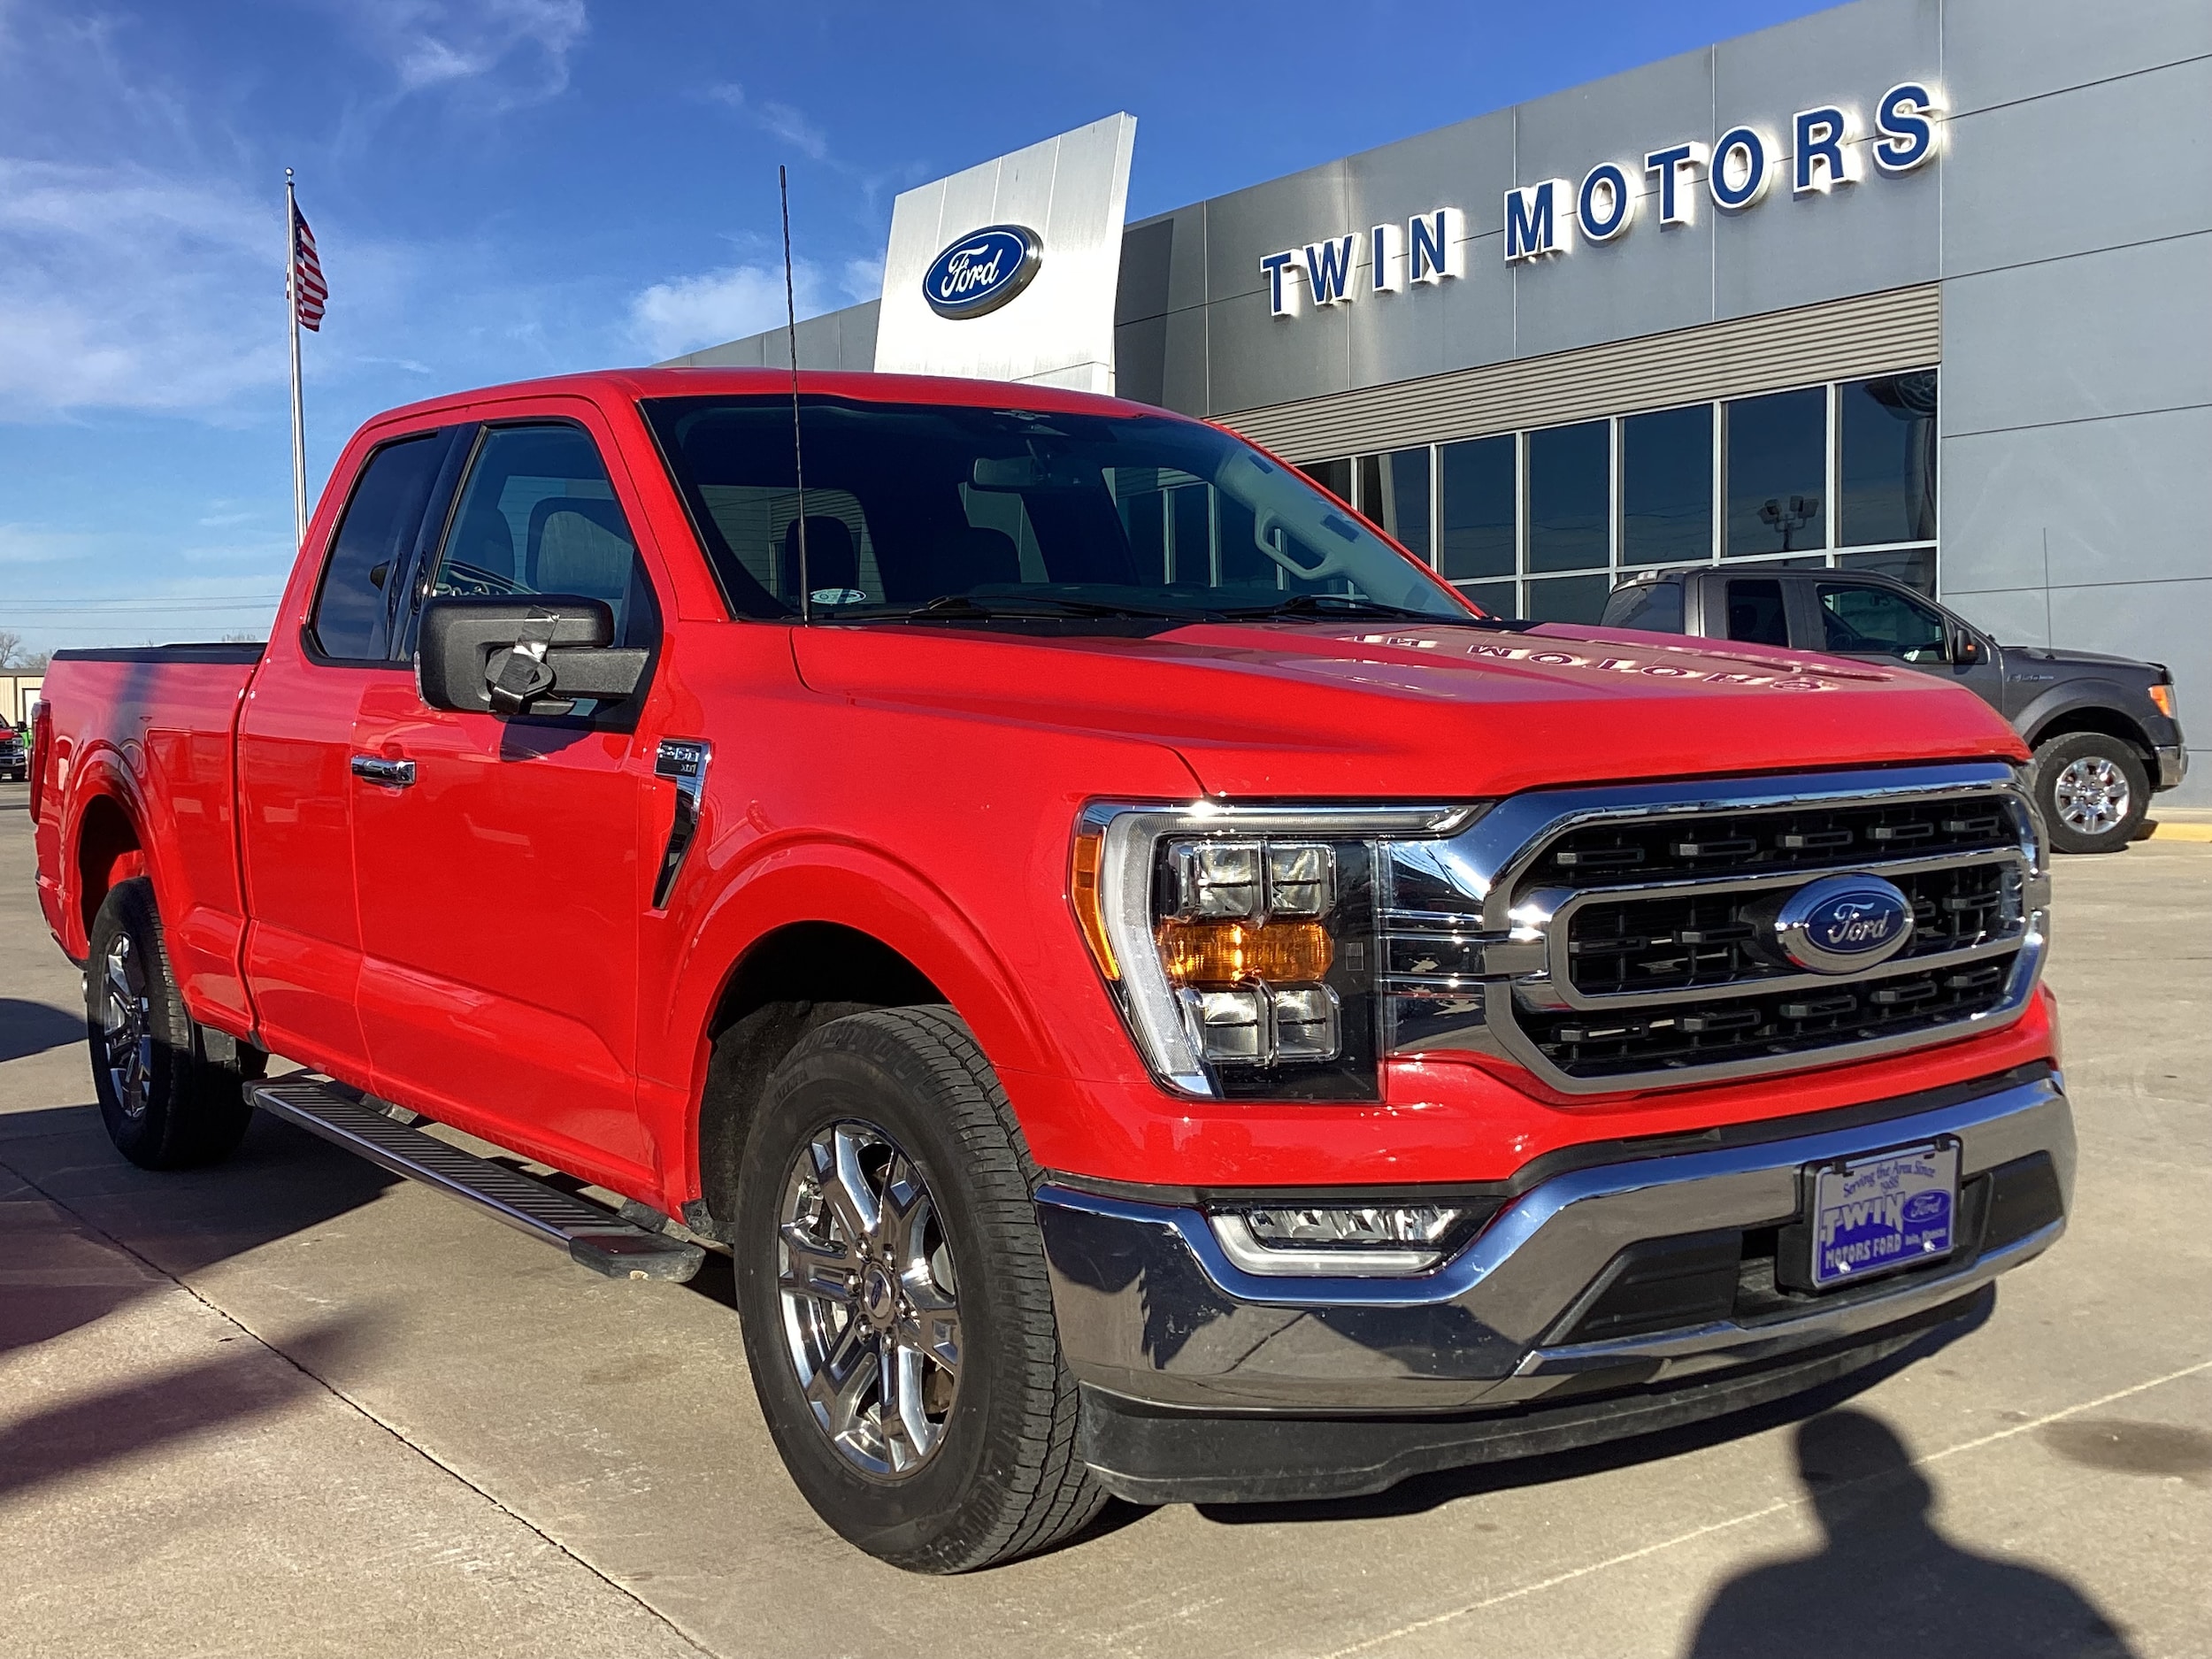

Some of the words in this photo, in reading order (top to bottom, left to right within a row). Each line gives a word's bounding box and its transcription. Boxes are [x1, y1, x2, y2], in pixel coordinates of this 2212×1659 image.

[1260, 207, 1462, 316] TWIN
[1504, 81, 1942, 262] MOTORS
[941, 243, 1002, 297] Ford
[1827, 902, 1890, 944] Ford
[1843, 1172, 1875, 1198] Serving
[1910, 1194, 1942, 1217] Ford
[1820, 1191, 1906, 1247] TWIN
[1825, 1240, 1870, 1269] MOTORS
[1873, 1233, 1901, 1257] FORD
